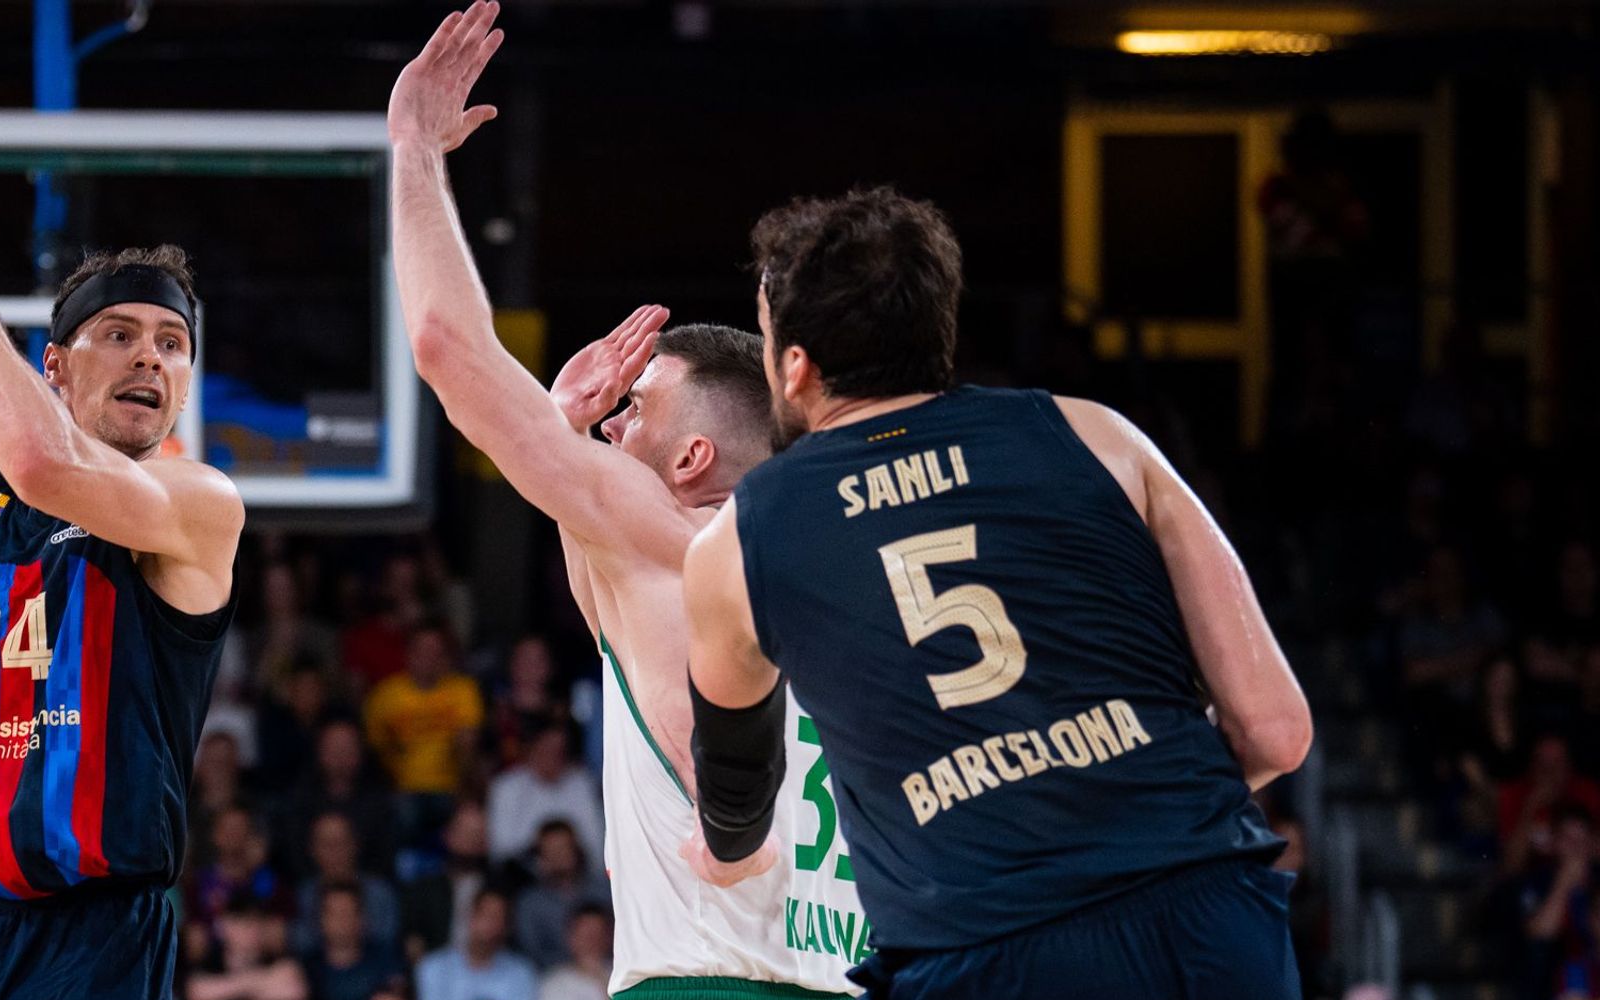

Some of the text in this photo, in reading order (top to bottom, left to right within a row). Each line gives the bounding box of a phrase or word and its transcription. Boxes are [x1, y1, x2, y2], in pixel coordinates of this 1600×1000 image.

[837, 445, 970, 517] SANLI
[878, 524, 1027, 711] 5
[795, 715, 856, 873] 3
[901, 699, 1152, 827] BARCELONA
